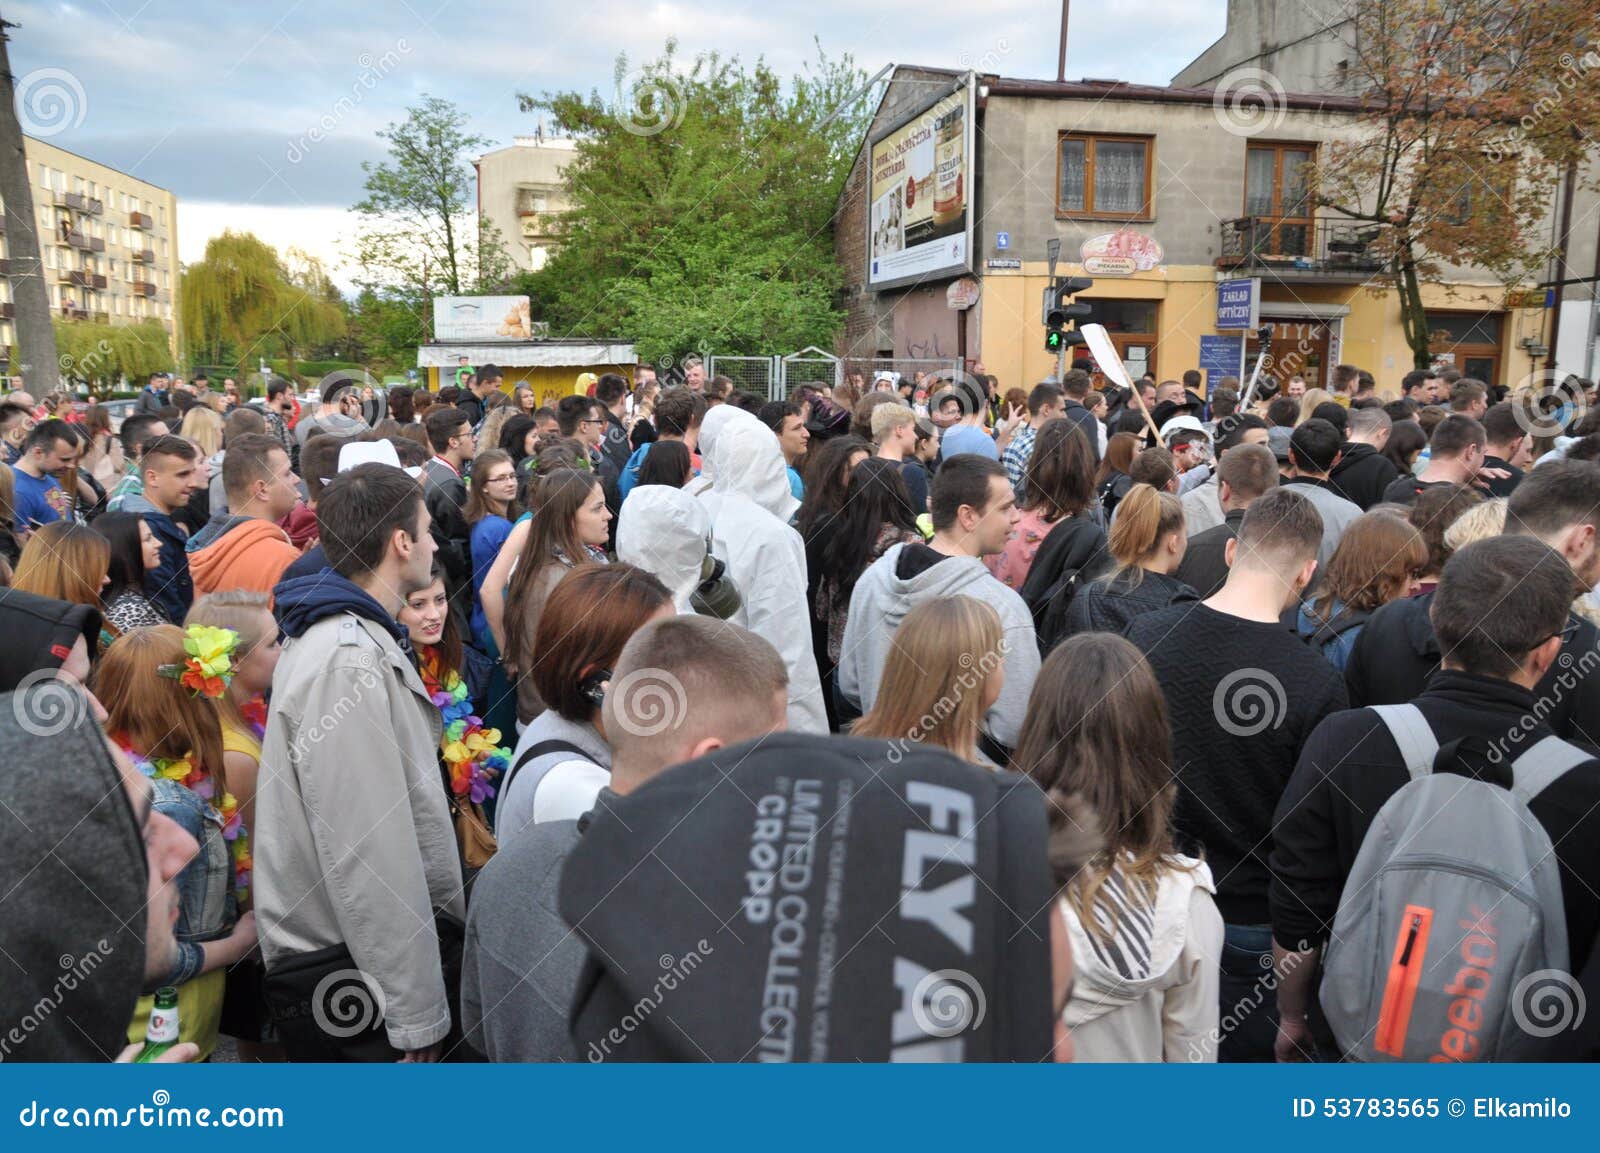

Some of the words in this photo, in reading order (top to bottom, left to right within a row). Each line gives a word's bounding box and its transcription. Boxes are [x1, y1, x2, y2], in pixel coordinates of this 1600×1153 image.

[741, 795, 787, 924] CROPP
[779, 779, 823, 892] LIMITED
[900, 780, 977, 955] FLY
